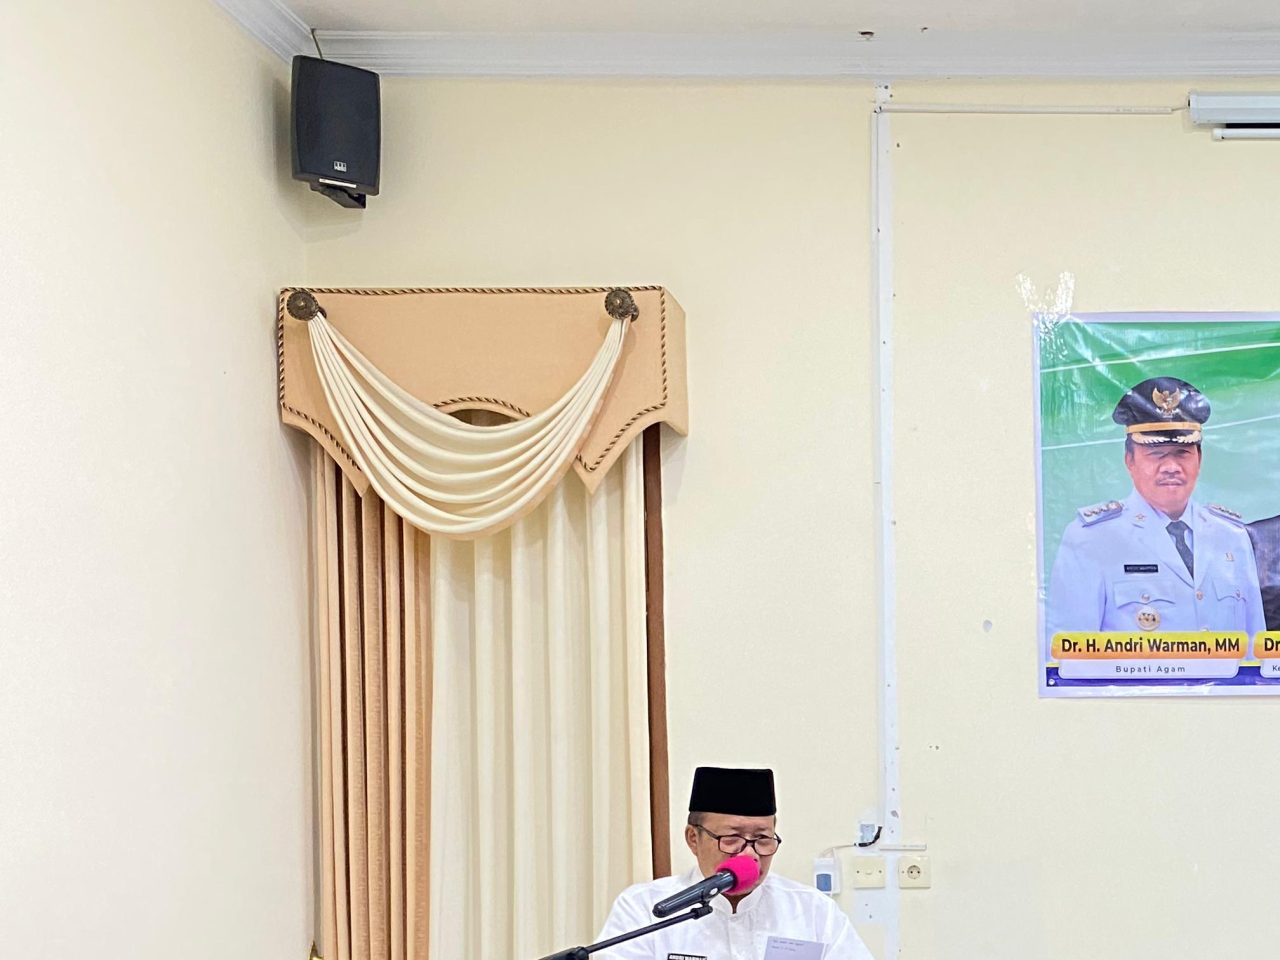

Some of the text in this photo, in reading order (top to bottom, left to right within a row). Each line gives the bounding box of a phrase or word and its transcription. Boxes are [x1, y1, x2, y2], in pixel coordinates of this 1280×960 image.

[1062, 638, 1239, 654] Dr. H. Andri Warman, MM
[1116, 665, 1185, 674] Bupati Agam
